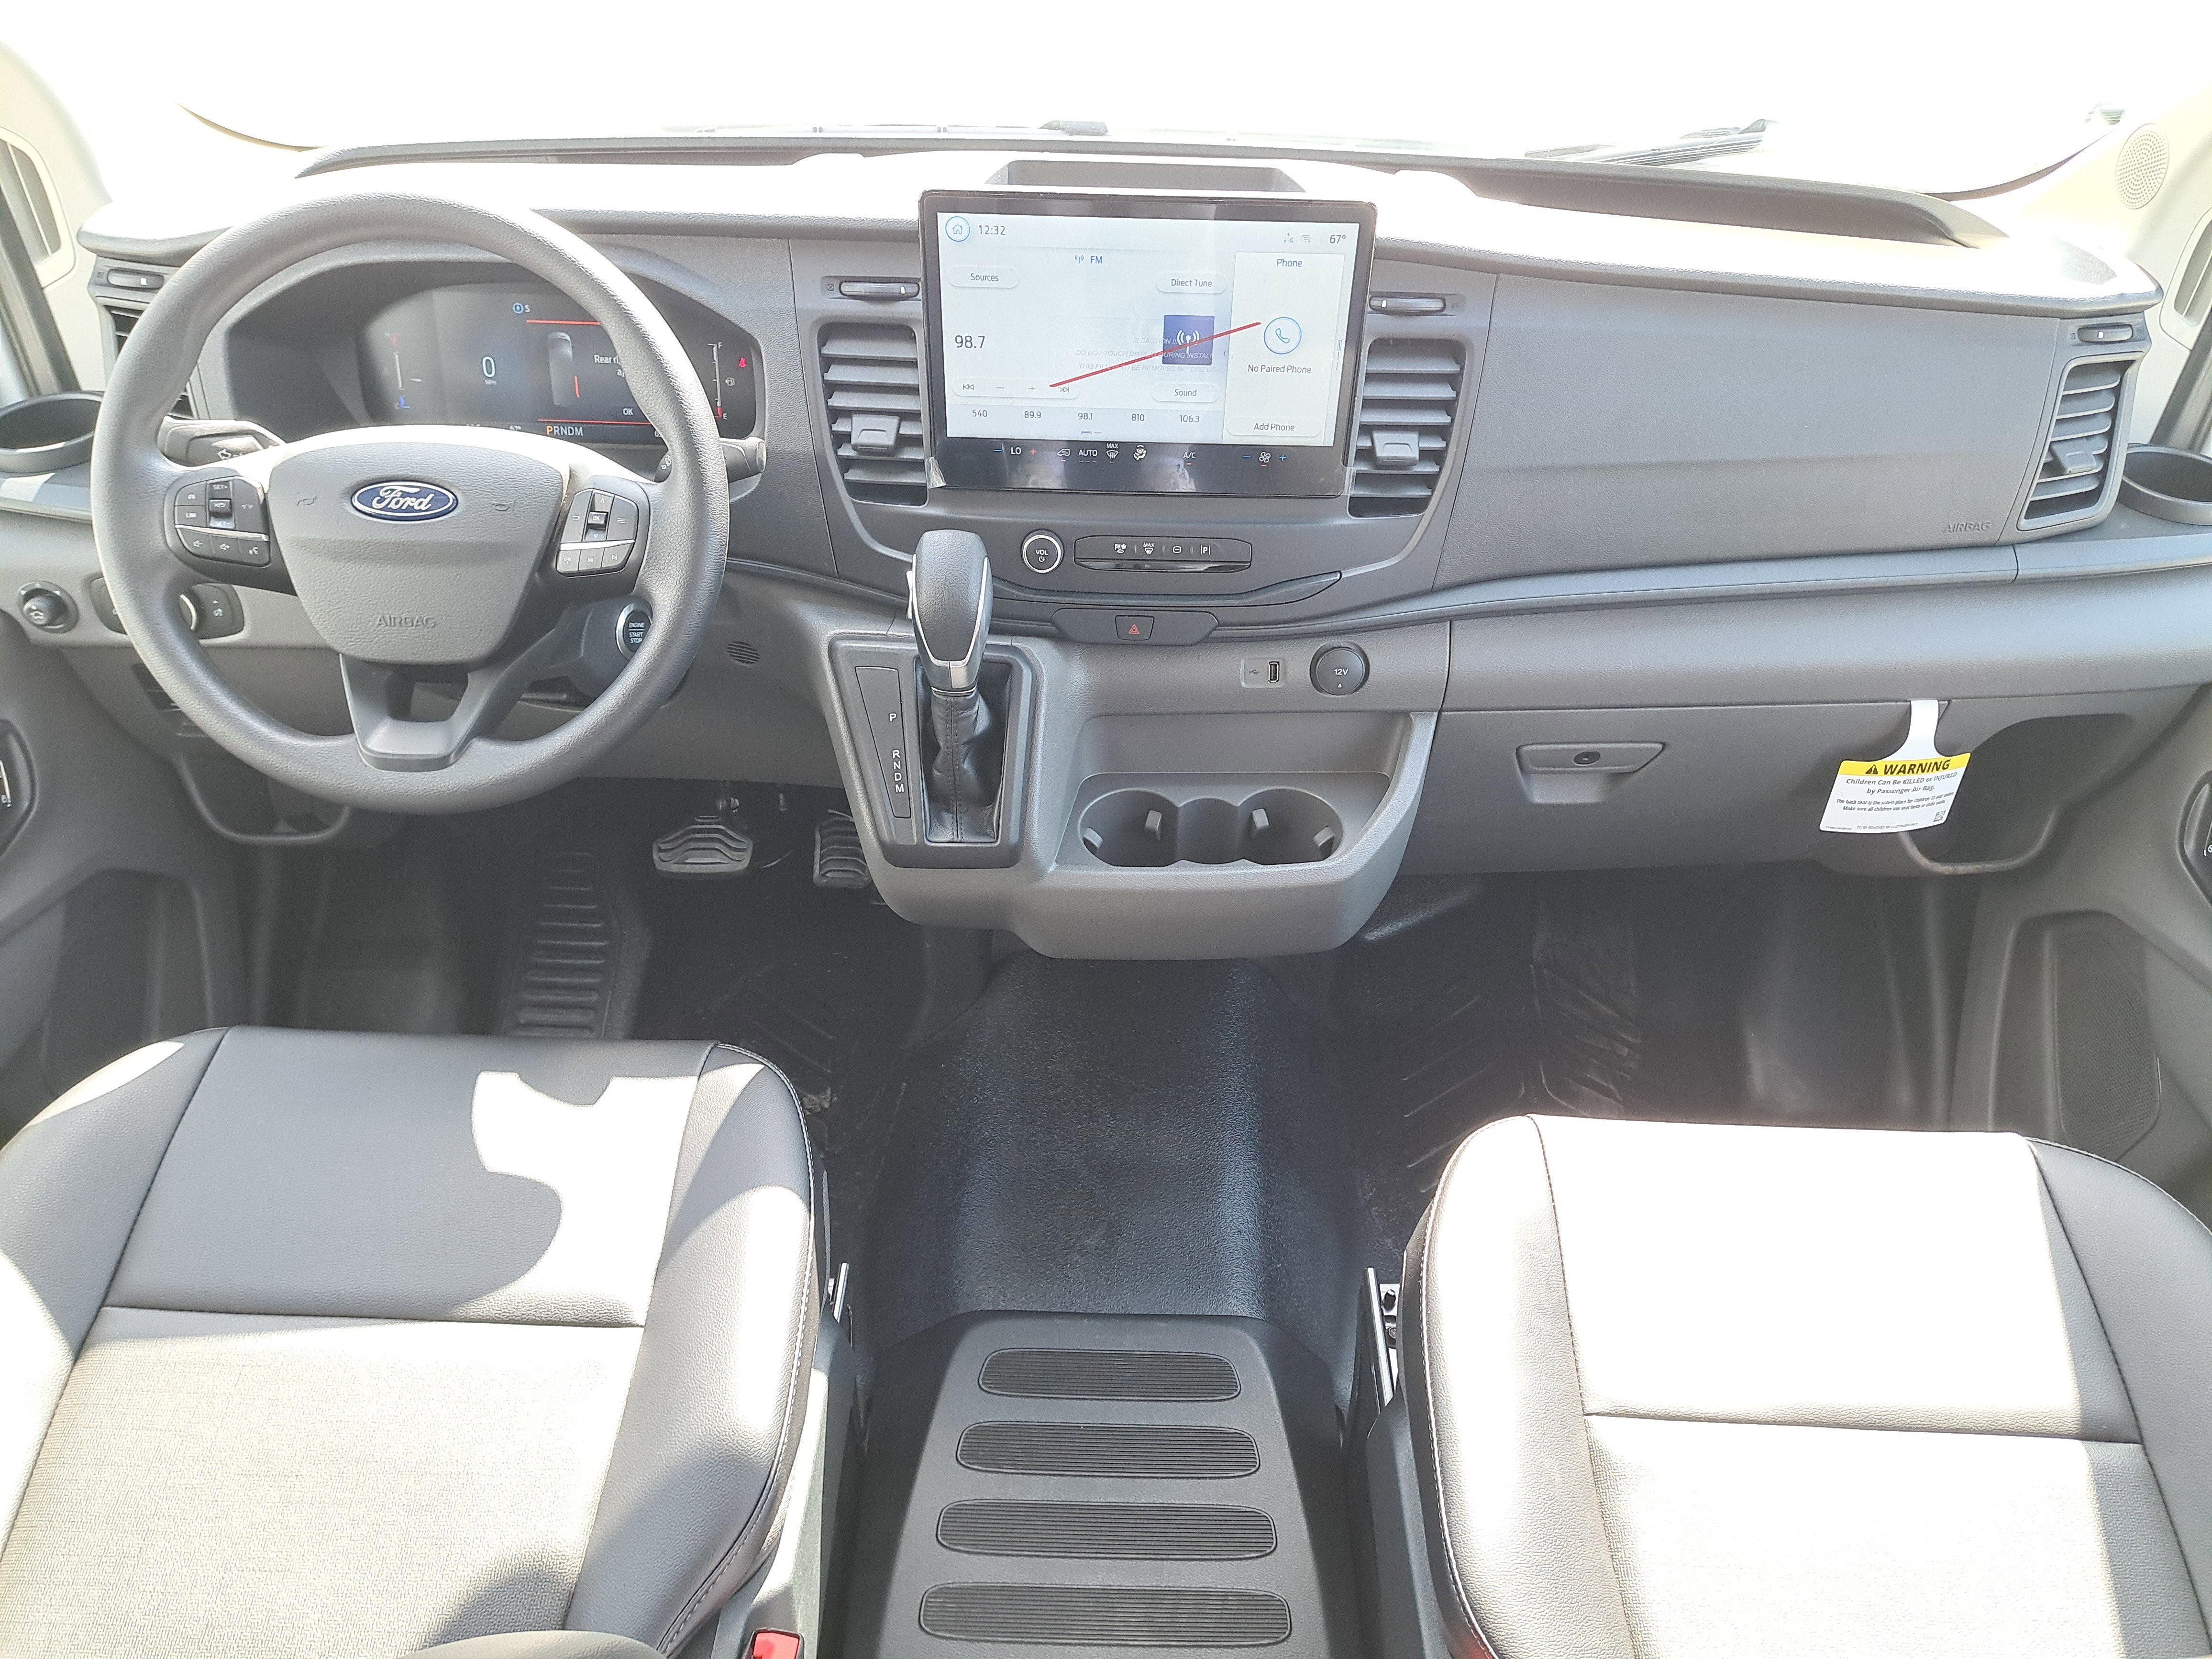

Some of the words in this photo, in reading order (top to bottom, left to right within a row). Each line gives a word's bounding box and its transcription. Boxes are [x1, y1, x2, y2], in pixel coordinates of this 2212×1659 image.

[978, 225, 1006, 235] 12:32
[1329, 234, 1346, 243] 67°
[1090, 255, 1103, 264] FM
[1277, 259, 1303, 267] Phone
[970, 273, 999, 282] Sources
[1171, 279, 1192, 287] Direct
[955, 335, 985, 349] 98.7
[594, 354, 612, 364] Rear
[482, 355, 496, 377] 0
[1248, 365, 1259, 373] No
[1261, 365, 1285, 373] Paired
[1287, 365, 1312, 374] Phone
[1024, 411, 1041, 419] 89.9
[1131, 414, 1145, 422] 810
[1180, 415, 1200, 423] 106.3
[546, 425, 583, 436] PRNDM
[1271, 423, 1295, 431] Phone
[1010, 447, 1022, 455] LO
[372, 486, 435, 511] Ford
[1944, 520, 1991, 533] AIRBAG
[376, 615, 436, 628] AIRBAG
[889, 713, 897, 722] P
[892, 749, 901, 759] R
[893, 761, 901, 770] N
[1883, 759, 1951, 775] WARNING
[894, 773, 903, 782] D
[1933, 772, 1958, 782] INJURED
[895, 784, 905, 793] M
